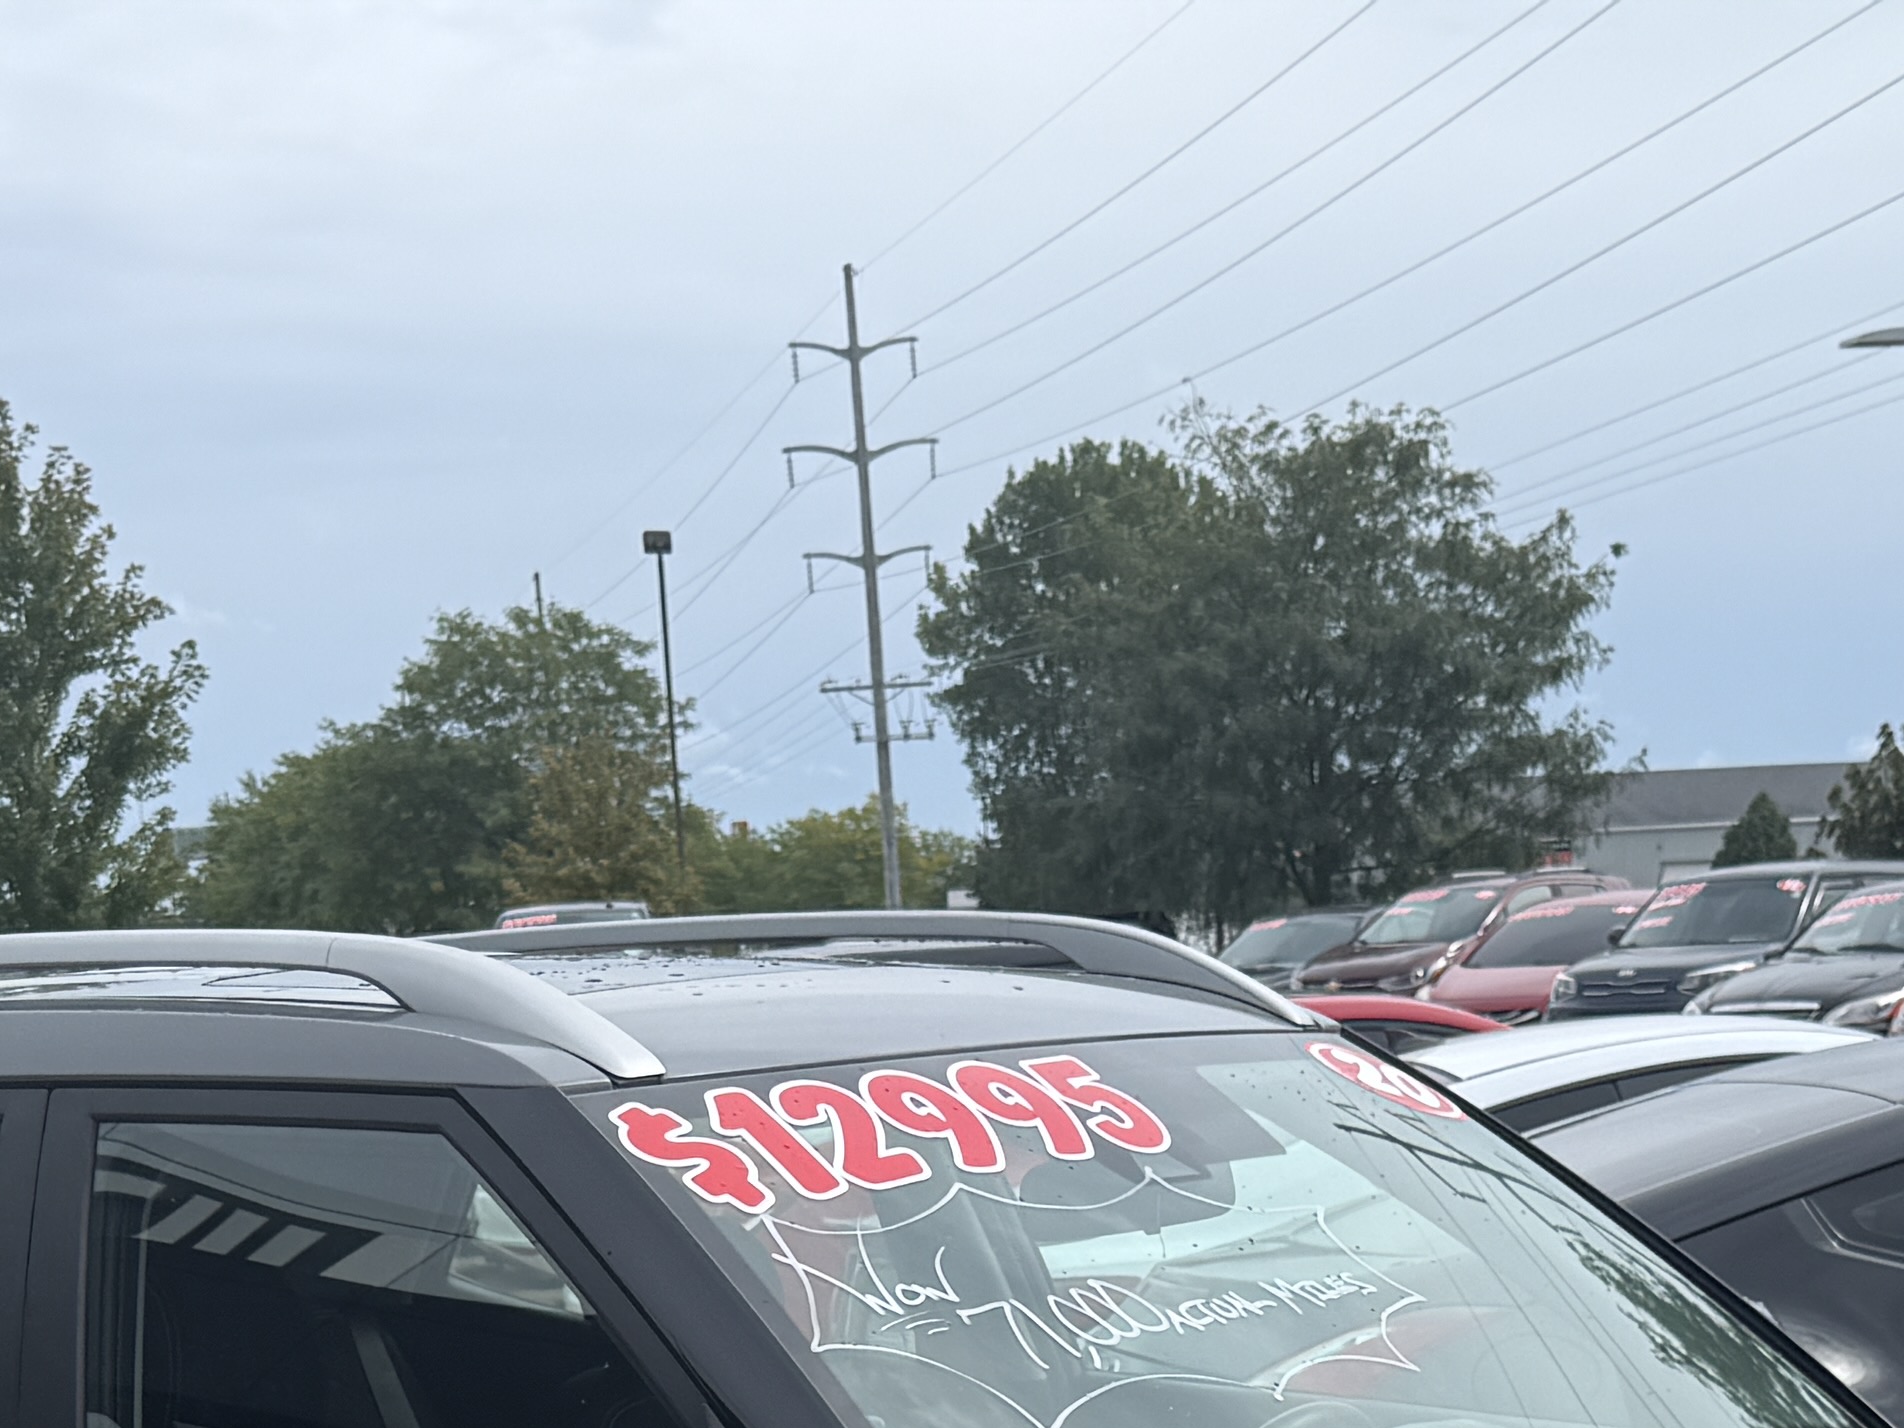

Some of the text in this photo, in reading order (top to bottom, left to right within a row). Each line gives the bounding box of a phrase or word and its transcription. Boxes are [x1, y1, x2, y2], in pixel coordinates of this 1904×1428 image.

[607, 1054, 1172, 1214] $12995
[1167, 1294, 1278, 1335] ACTUAL
[1259, 1271, 1378, 1316] MILES
